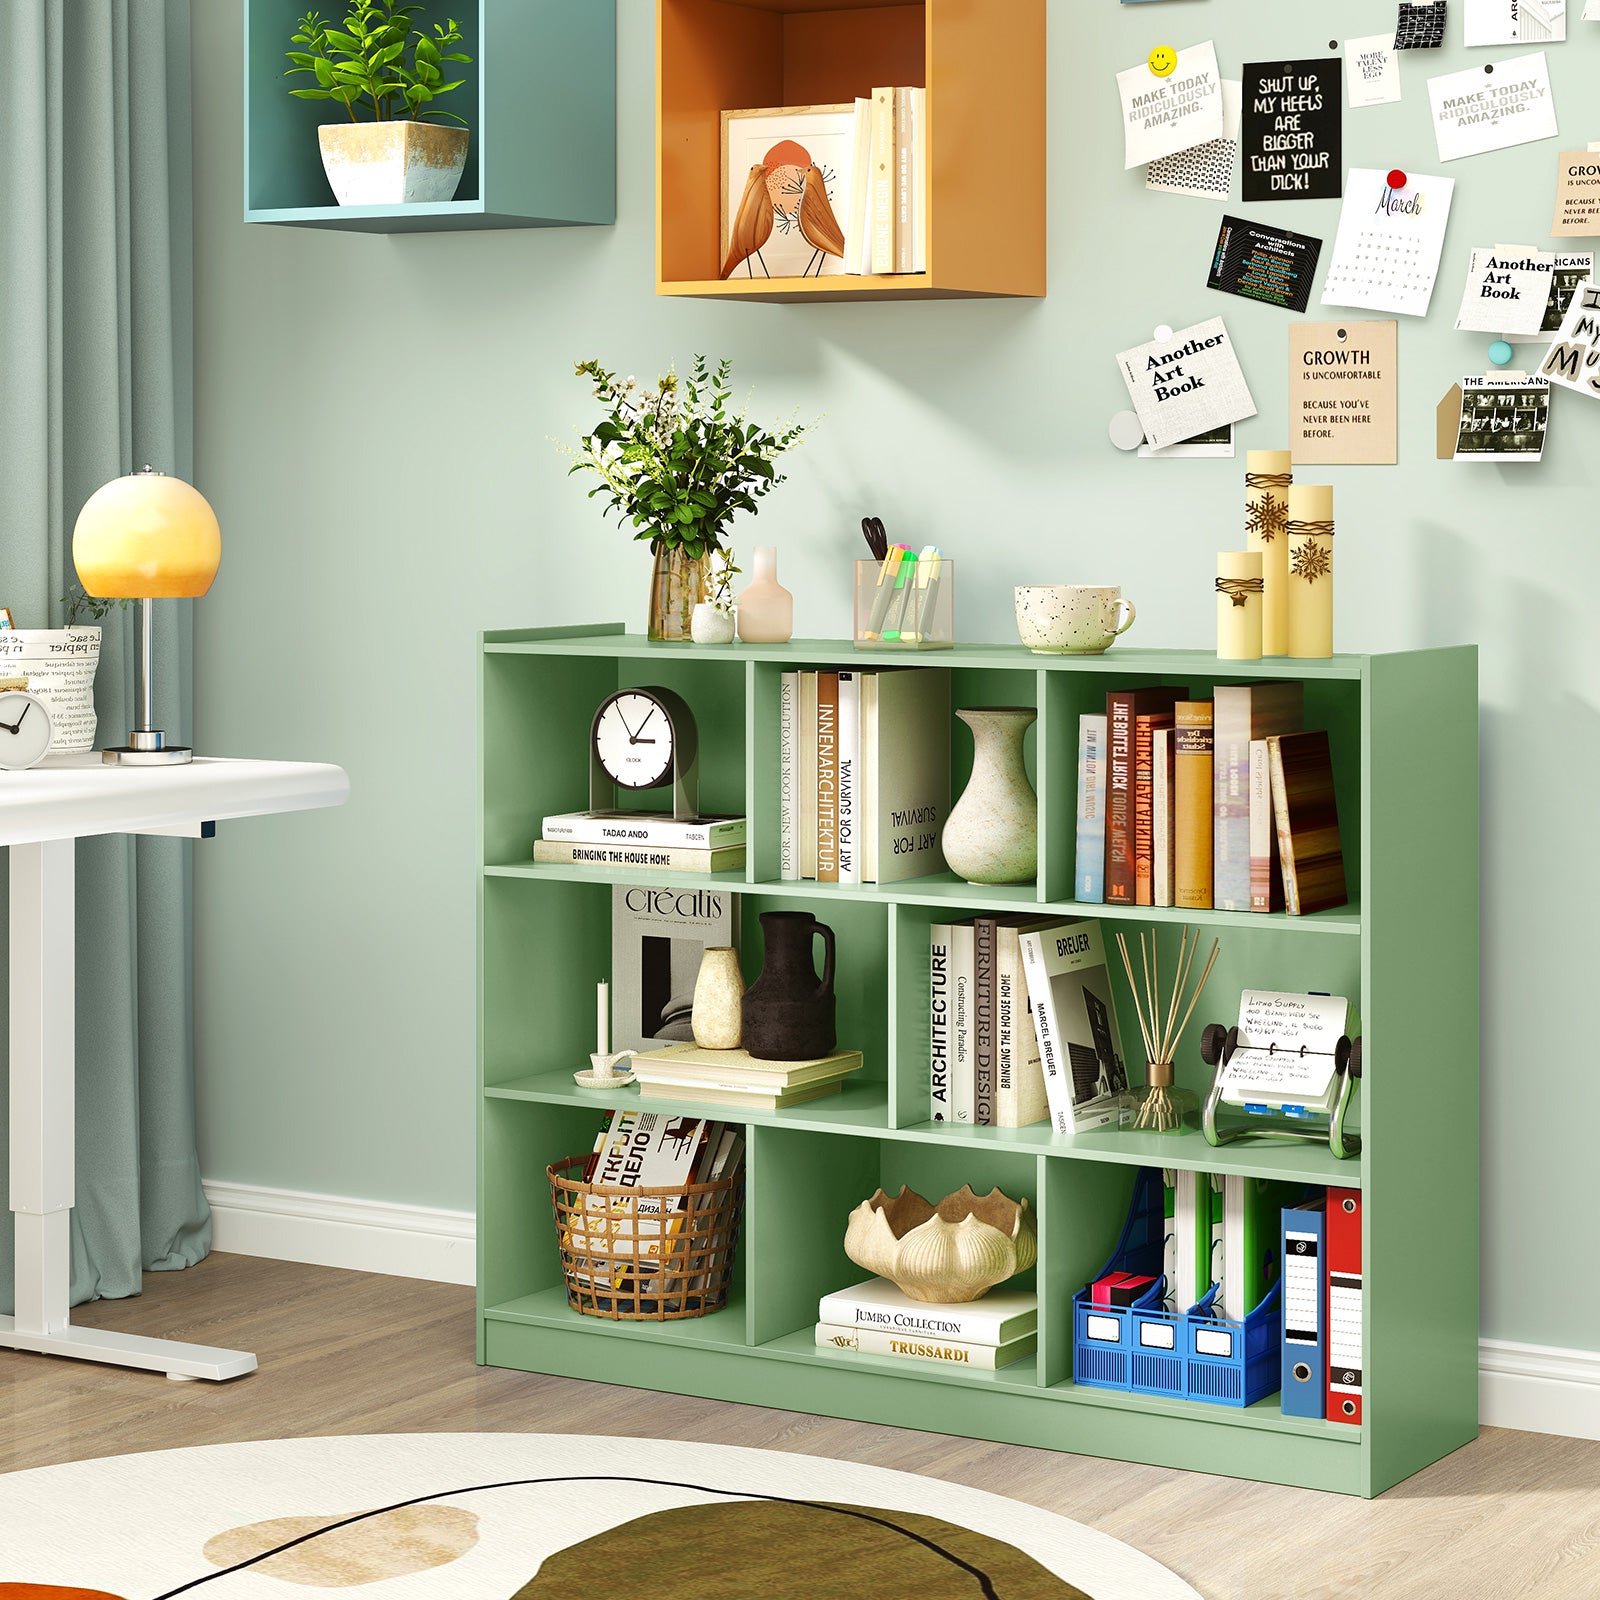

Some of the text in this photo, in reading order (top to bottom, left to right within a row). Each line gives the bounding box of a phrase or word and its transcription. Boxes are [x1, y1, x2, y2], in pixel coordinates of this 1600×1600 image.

[1132, 72, 1210, 108] MAKE TODAY
[1259, 75, 1320, 94] SHUT UP,
[1443, 79, 1538, 110] MAKE TODAY
[1129, 83, 1216, 122] RIDICULOUSLY
[1254, 94, 1323, 113] MY HEELS
[1439, 88, 1546, 121] RIDICULOUSLY
[1144, 101, 1204, 129] AMAZING.
[1275, 115, 1301, 131] ARE
[1457, 103, 1531, 127] AMAZING.
[1263, 132, 1314, 151] BIGGER
[901, 165, 908, 175] DO
[1250, 152, 1330, 172] THAN YOUR
[901, 175, 908, 187] WE
[1271, 174, 1310, 191] DICK!
[1374, 186, 1422, 216] March
[875, 179, 889, 267] EUGENE ONEGIN
[1249, 230, 1306, 250] Conversations
[1254, 242, 1295, 257] Architects
[1267, 240, 1285, 249] with
[1486, 256, 1554, 272] Another
[1483, 271, 1512, 285] Art
[1480, 285, 1521, 300] Book
[1145, 333, 1225, 371] Another
[1303, 350, 1370, 366] GROWTH
[1152, 364, 1185, 386] Art
[1303, 371, 1382, 380] IS UNCOMFORTABLE
[1464, 378, 1483, 386] THE
[1154, 376, 1205, 402] Book
[1303, 400, 1370, 409] BECAUSE YOU'VE
[1303, 414, 1371, 424] NEVER BEEN HERE
[1303, 429, 1335, 438] BEFORE.
[781, 683, 791, 763] REVOLUTION
[781, 767, 791, 804] LOOK
[818, 703, 835, 872] INNENARCHITEKTUR
[781, 805, 791, 833] NEW
[840, 759, 852, 872] ART FOR SURVIVAL
[891, 806, 937, 828] SURVIVAL
[602, 828, 627, 838] TADAO
[628, 829, 649, 839] ANDO
[893, 832, 937, 855] ART FOR
[572, 849, 671, 865] BRINGING THE HOUSE HOME
[625, 887, 722, 920] créatis
[1056, 933, 1090, 957] BREUER
[957, 976, 967, 1027] Constructing
[932, 944, 947, 1103] ARCHITECTURE
[977, 923, 991, 1126] FURNITURE DESIGN
[1001, 973, 1011, 1089] BRINGING THE HOUSE HOME
[1036, 1002, 1057, 1077] MARCEL BREUER
[855, 1308, 962, 1334] JUMBO COLLECTION
[889, 1339, 969, 1363] TRUSSARDI
